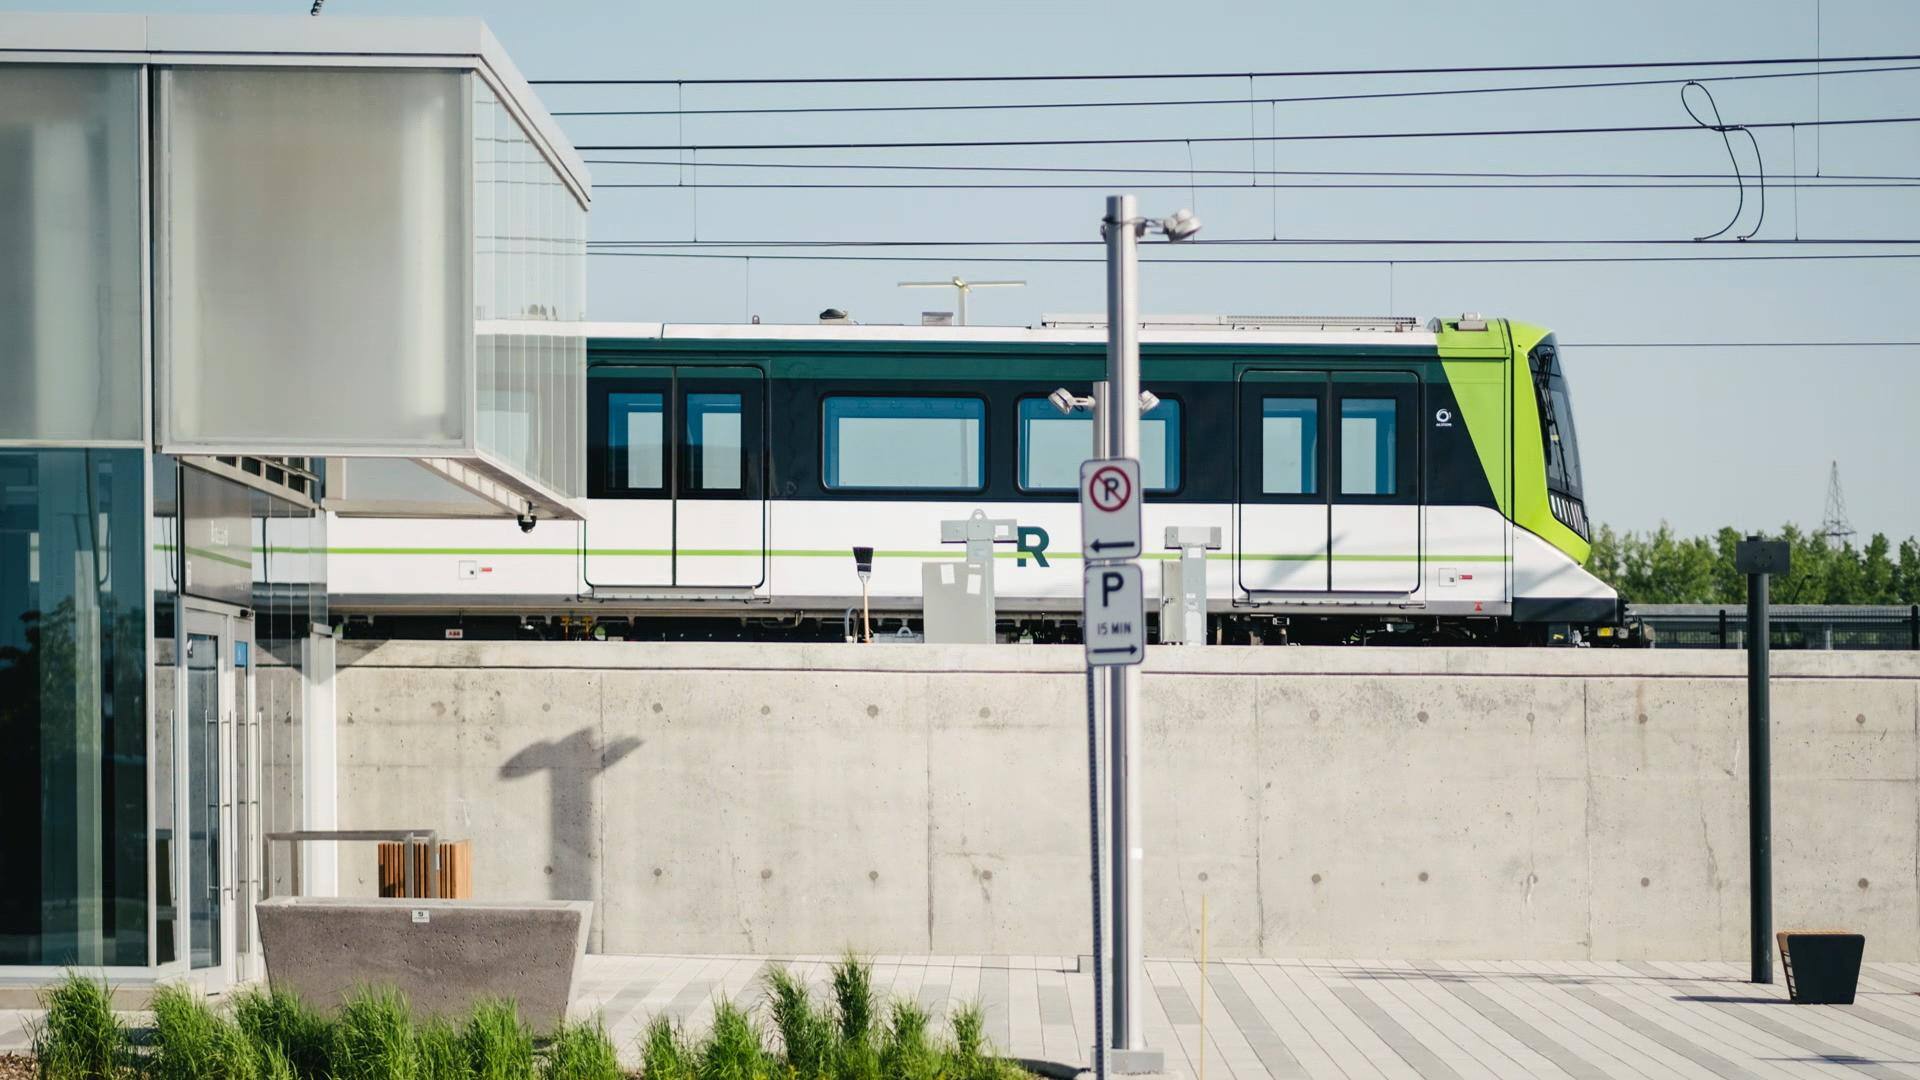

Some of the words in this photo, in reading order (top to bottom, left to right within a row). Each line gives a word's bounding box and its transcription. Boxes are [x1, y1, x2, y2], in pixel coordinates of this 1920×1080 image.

[1017, 526, 1050, 568] R
[1102, 571, 1124, 608] P
[1097, 622, 1108, 635] 15
[1111, 621, 1131, 635] MIN
